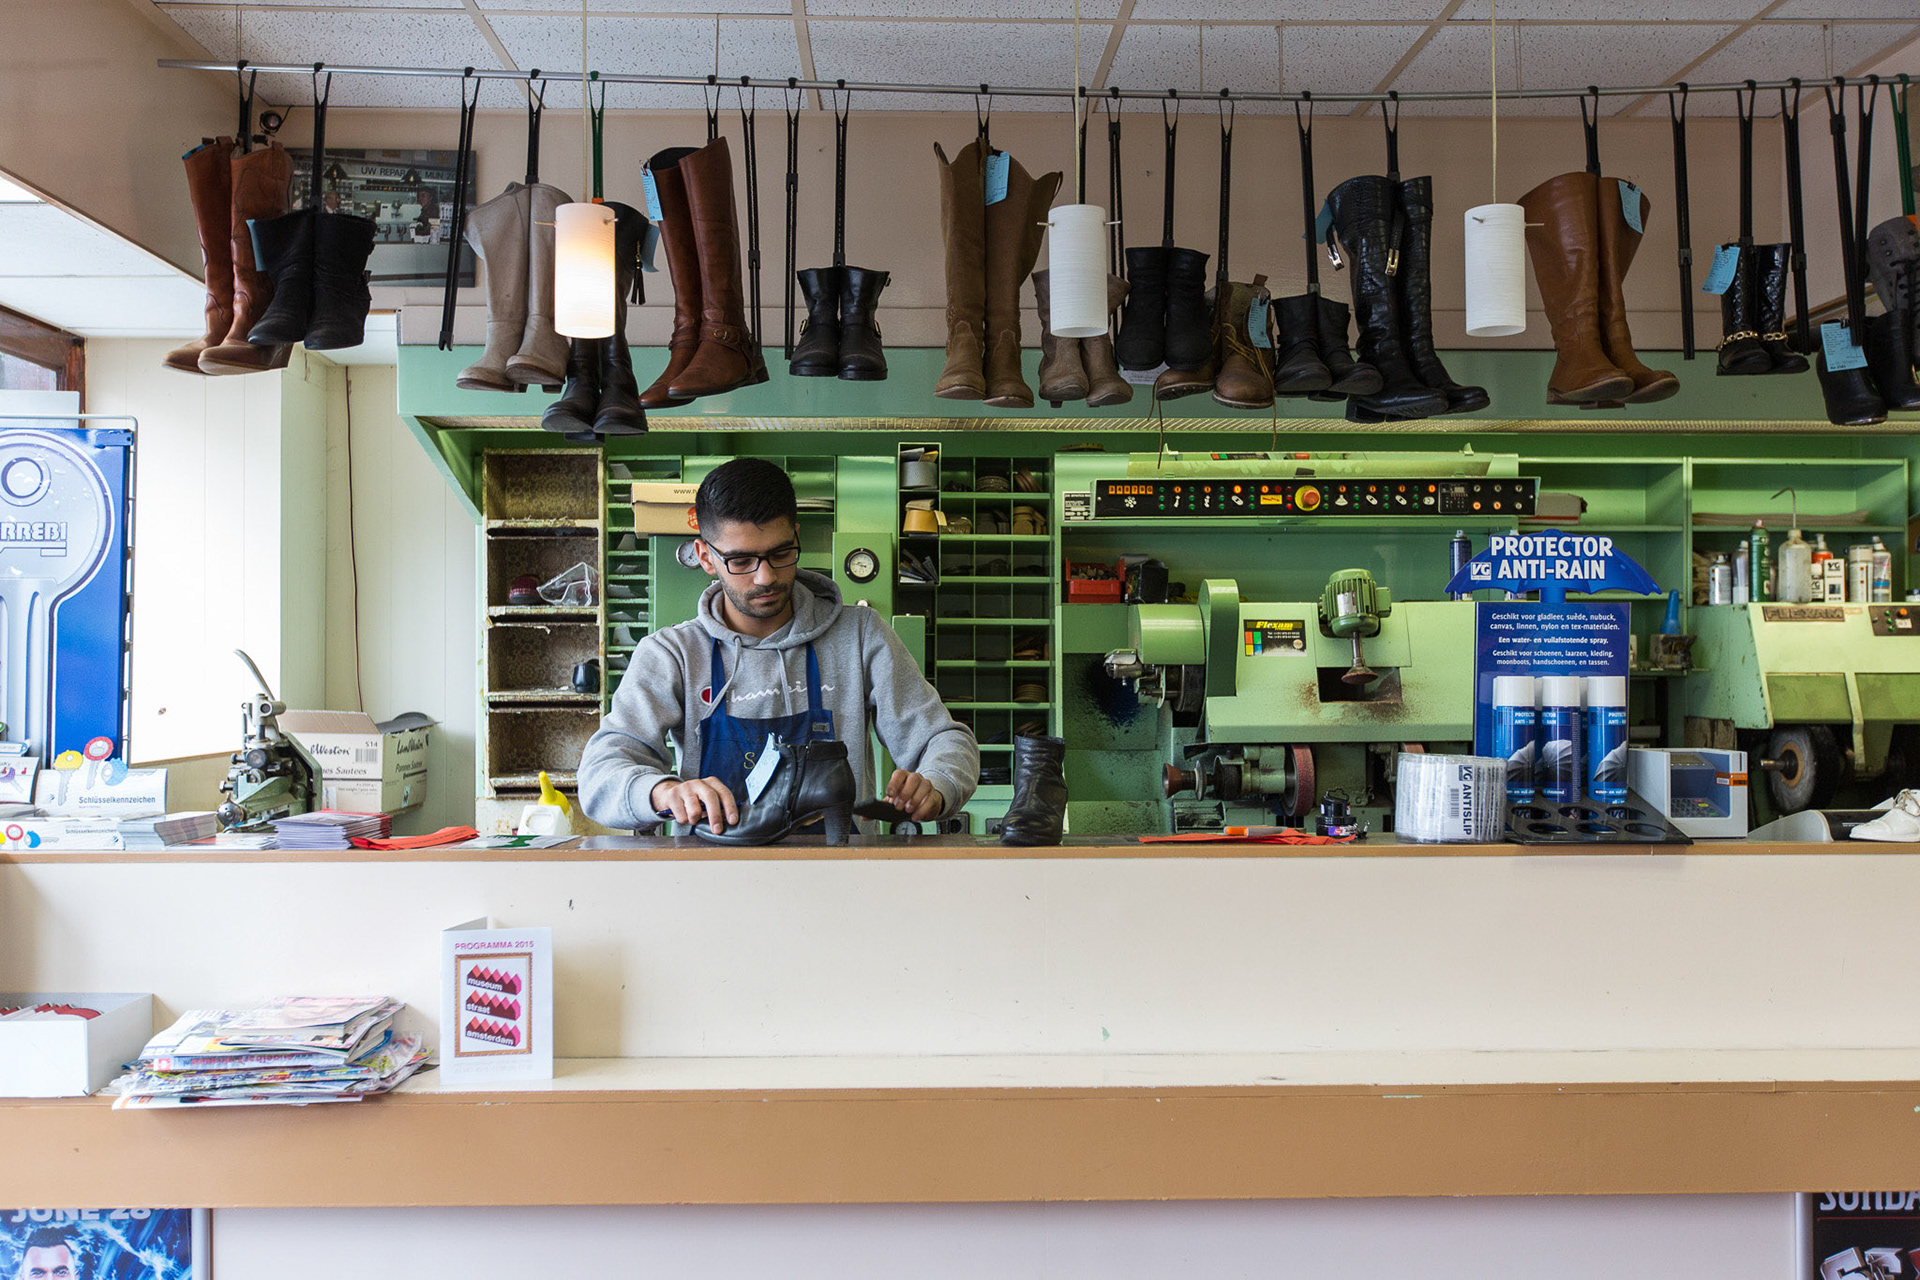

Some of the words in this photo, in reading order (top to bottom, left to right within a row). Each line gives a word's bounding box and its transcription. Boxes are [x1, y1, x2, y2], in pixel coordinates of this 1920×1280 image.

[0, 521, 67, 541] RREBI
[1491, 536, 1613, 557] PROTECTOR
[1471, 563, 1491, 576] VG
[1497, 560, 1605, 579] ANTI-RAIN
[1566, 612, 1588, 621] suède,
[1590, 613, 1616, 621] nubuck,
[1766, 607, 1843, 619] FLEXAM
[1591, 650, 1614, 658] kleding,
[1463, 766, 1472, 781] VG
[1463, 784, 1473, 835] ANTISLIP
[455, 942, 512, 950] PROGRAMMA
[467, 978, 503, 990] museum
[466, 1003, 490, 1014] straat
[466, 1030, 514, 1045] amsterdam
